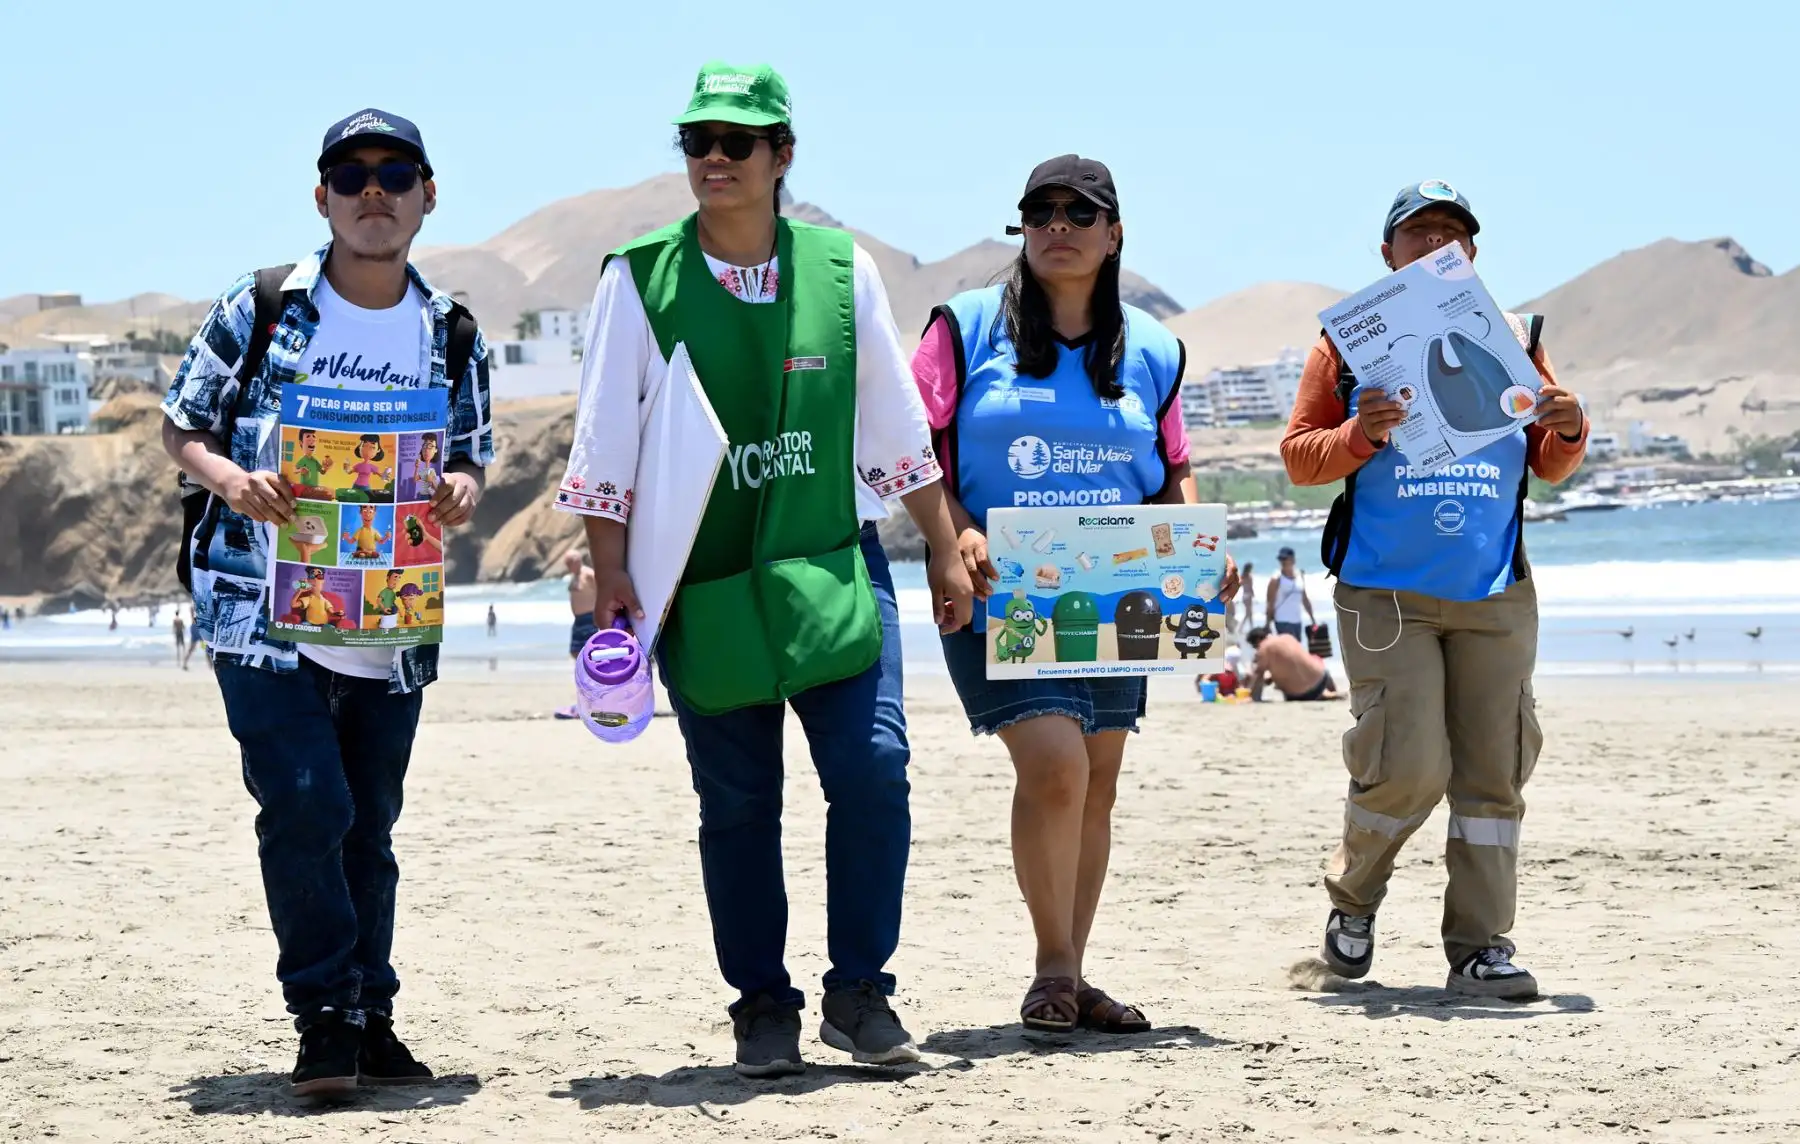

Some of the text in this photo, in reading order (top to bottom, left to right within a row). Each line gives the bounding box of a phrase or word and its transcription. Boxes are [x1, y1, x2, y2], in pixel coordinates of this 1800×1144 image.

[1338, 312, 1382, 339] Gracias
[1346, 322, 1388, 353] pero NO
[296, 395, 408, 418] 7 IDEAS PARA SER UN
[310, 409, 438, 424] CONSUMIDOR RESPONSABLE
[1052, 445, 1133, 463] Santa María
[726, 443, 763, 490] YO
[1052, 459, 1104, 474] del Mar
[1394, 463, 1501, 480] PRMOTOR
[1013, 487, 1121, 507] PROMOTOR
[1397, 481, 1500, 498] AMBIENTAL
[1037, 668, 1072, 676] Encuentra
